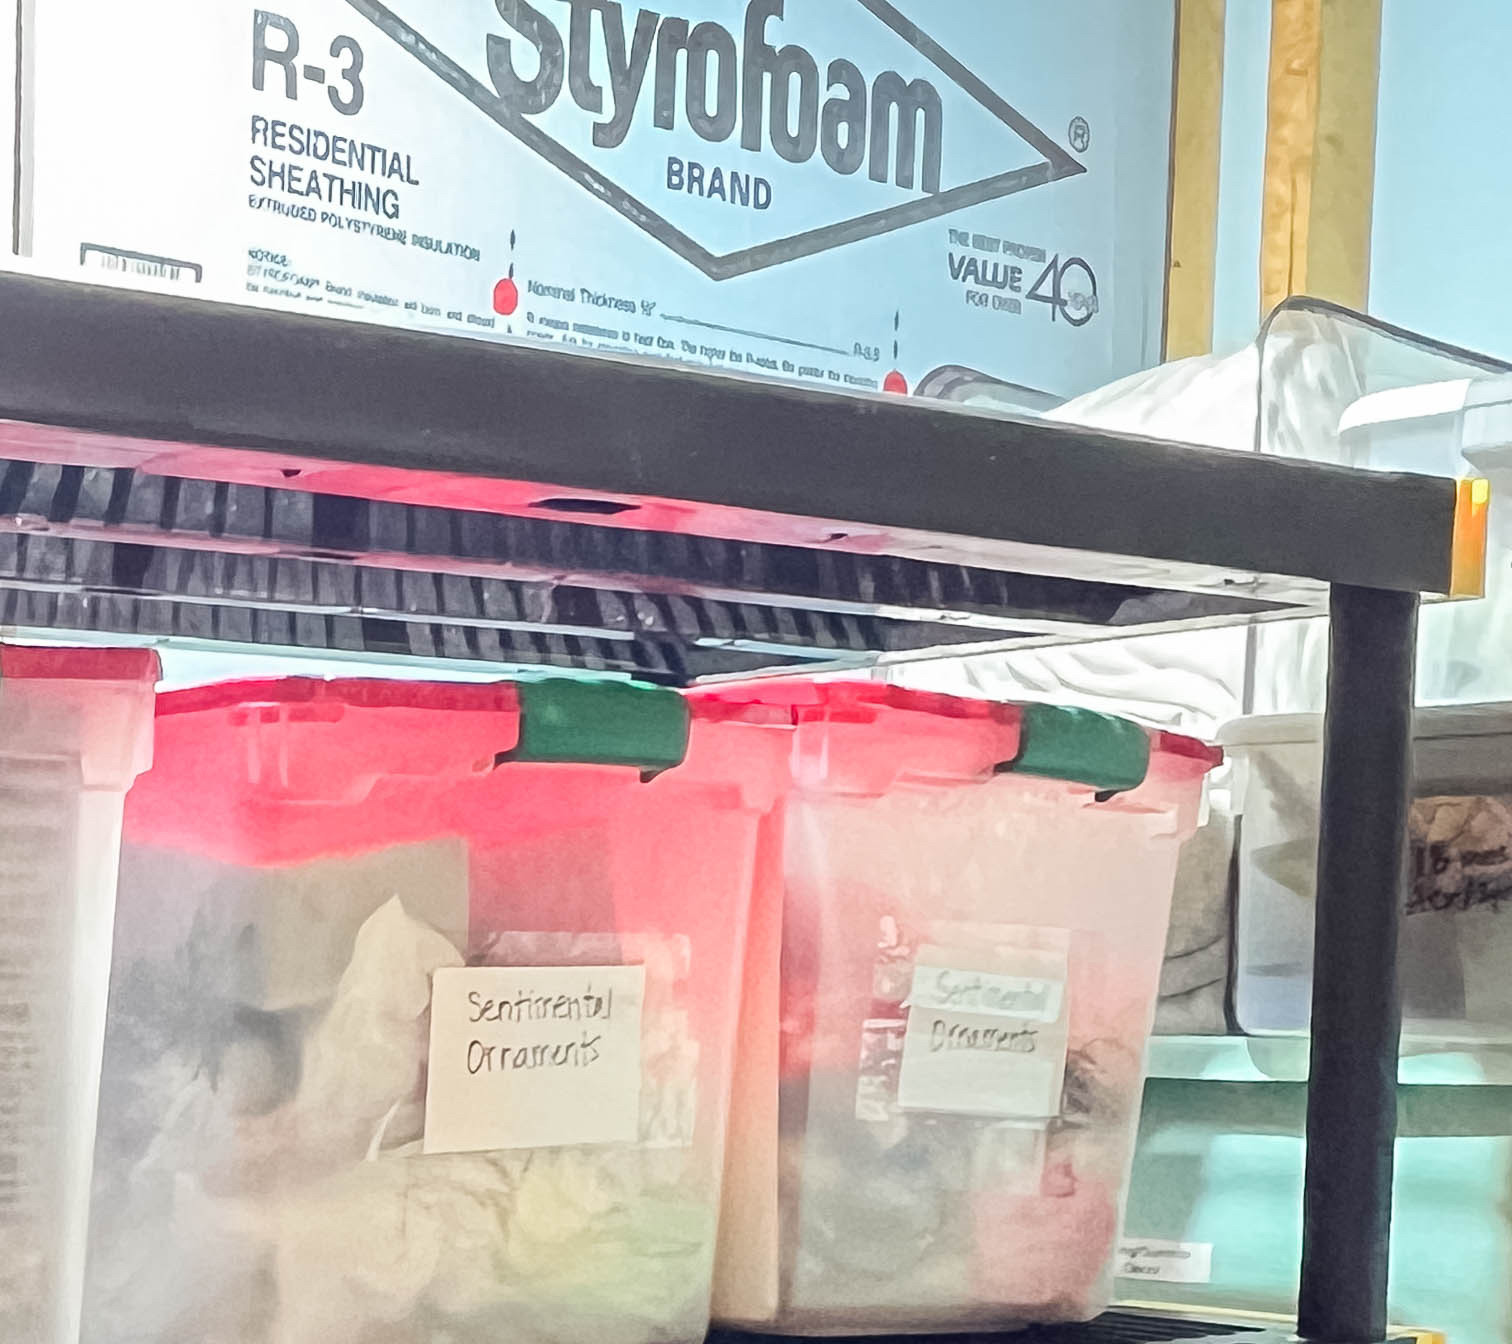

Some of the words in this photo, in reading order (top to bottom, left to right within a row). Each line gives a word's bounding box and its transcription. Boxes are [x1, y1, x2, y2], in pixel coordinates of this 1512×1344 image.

[251, 8, 365, 116] R-3
[486, 0, 943, 193] Styrofoam
[250, 115, 420, 187] RESIDENTIAL
[666, 155, 773, 211] BRAND
[249, 156, 400, 220] SHEATHING
[948, 252, 1023, 293] VALUE
